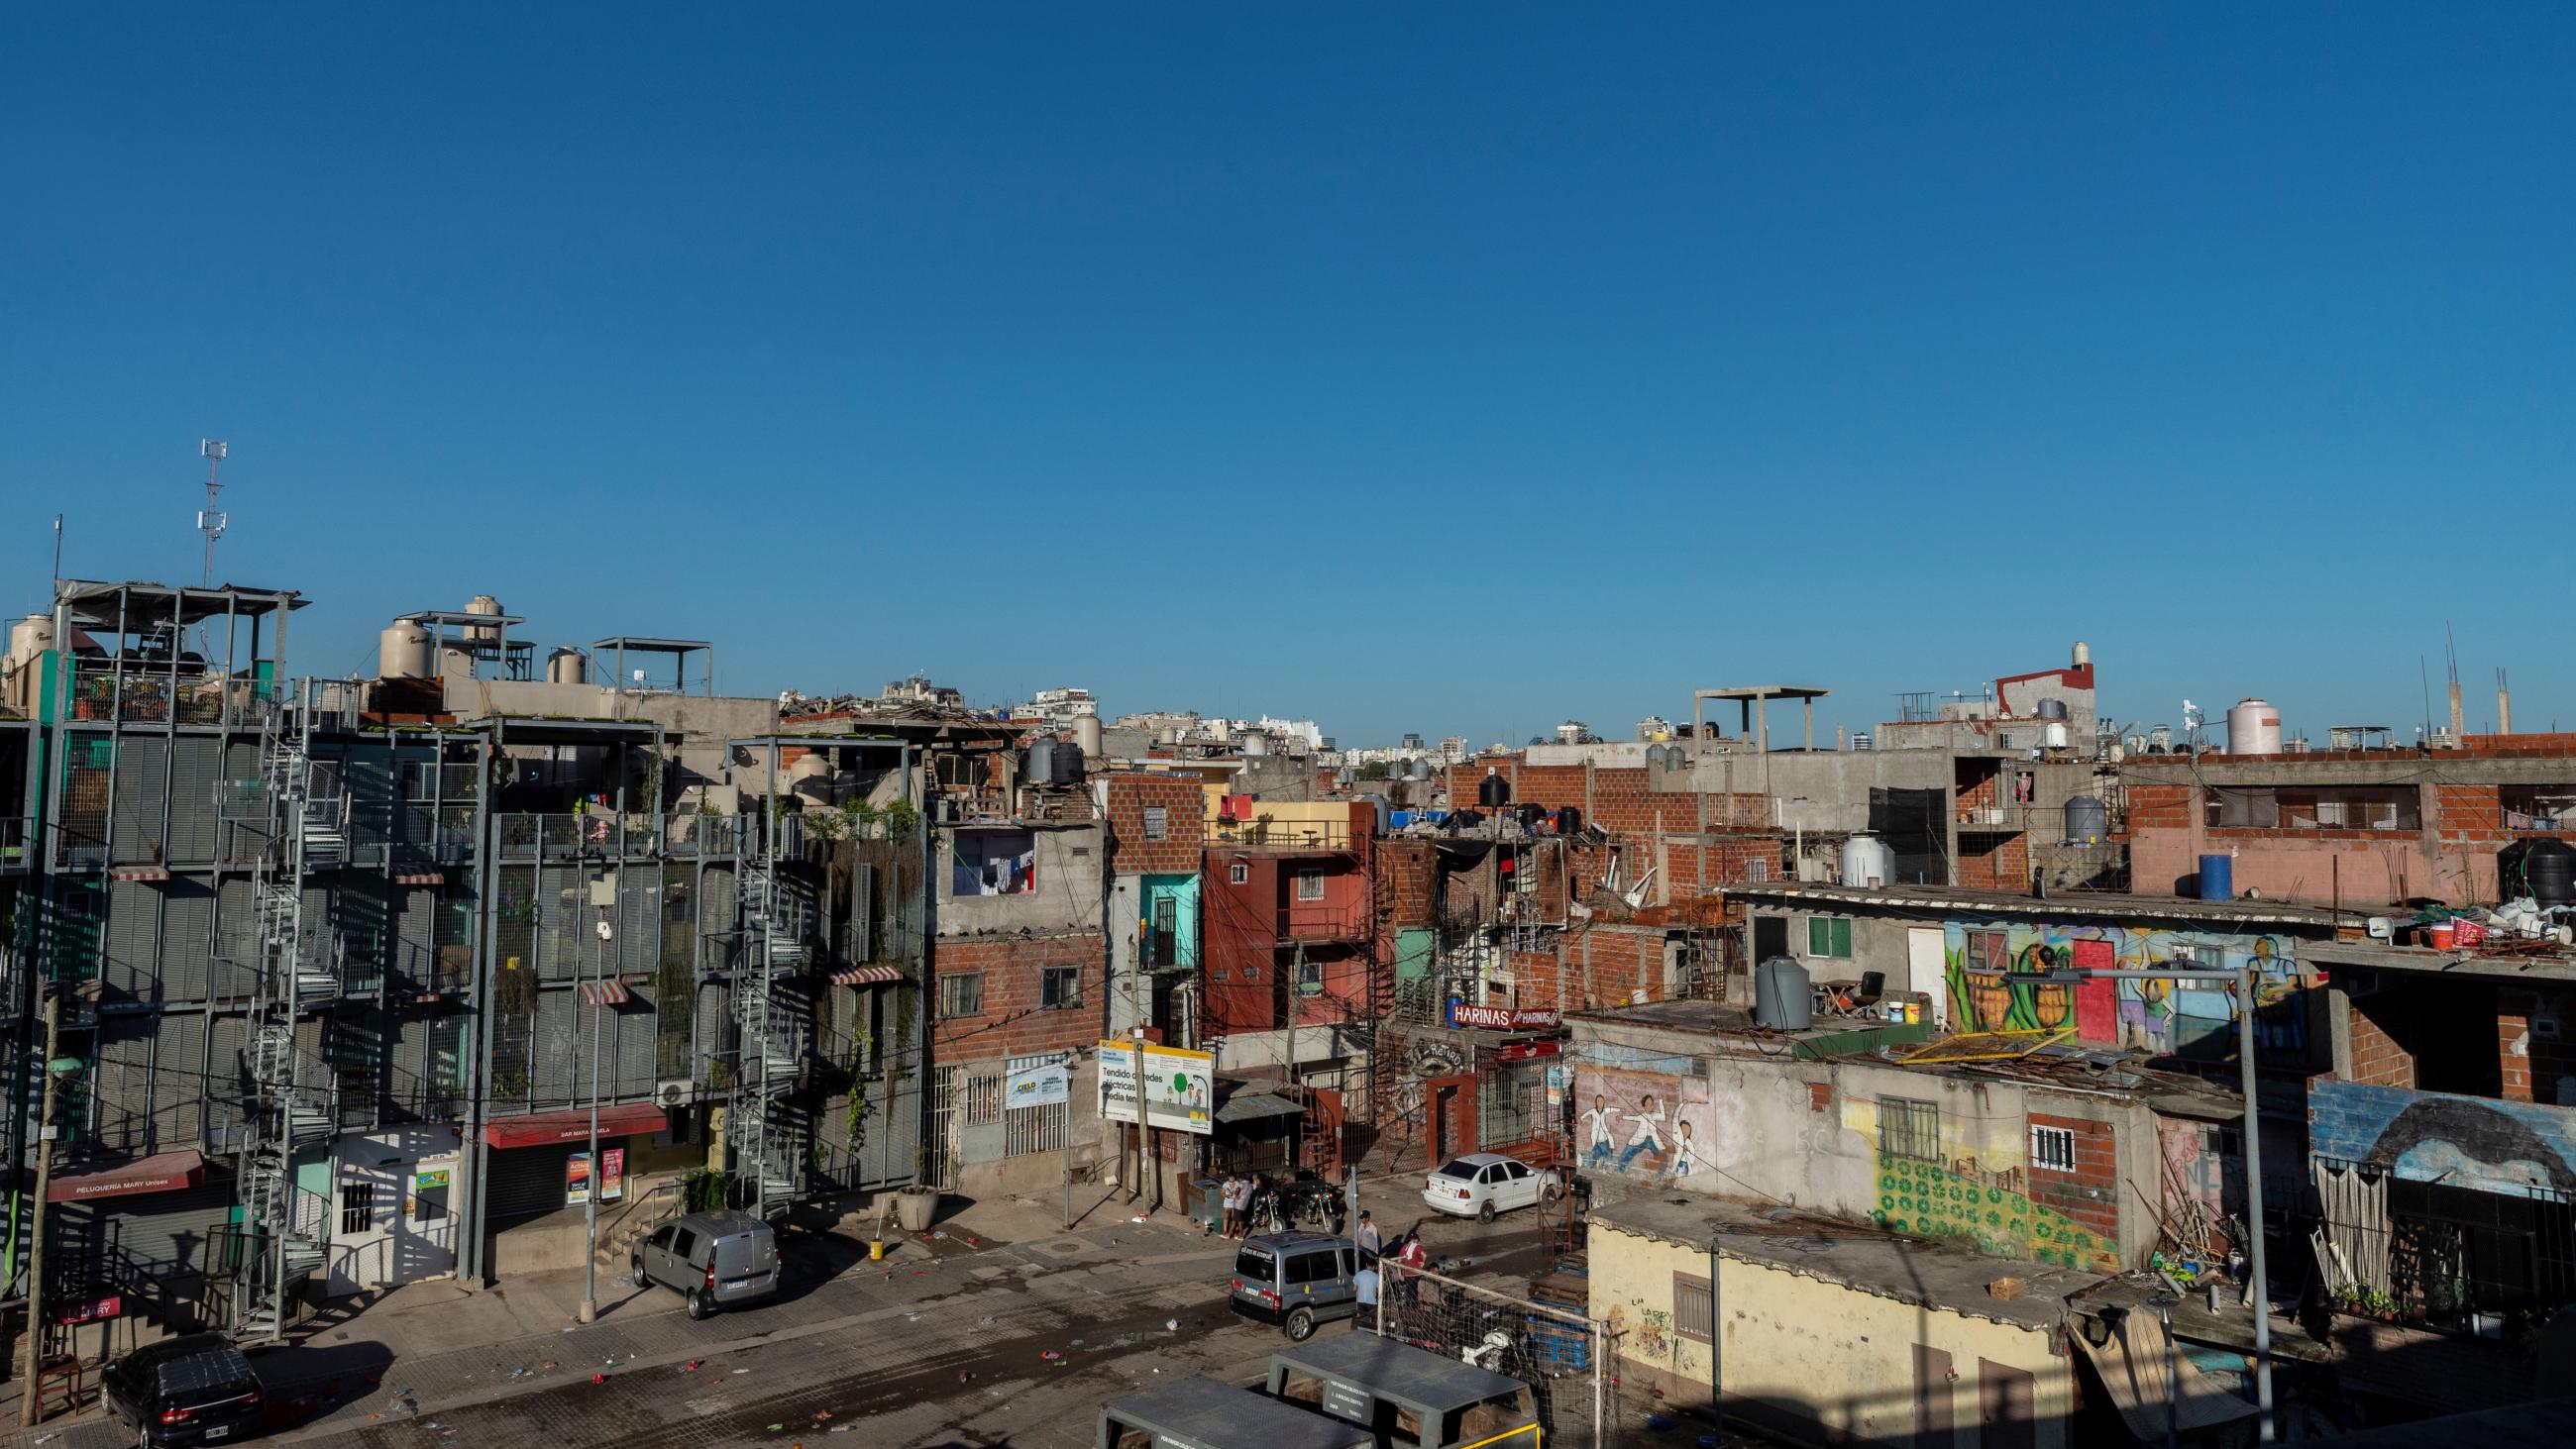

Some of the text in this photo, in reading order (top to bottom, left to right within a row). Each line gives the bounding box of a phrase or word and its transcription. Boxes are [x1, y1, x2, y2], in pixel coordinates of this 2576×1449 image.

[1454, 1005, 1509, 1026] HARINAS
[1522, 1011, 1550, 1024] HARINAS
[1102, 1067, 1130, 1079] Tendido
[1017, 1082, 1036, 1091] CIELO
[1102, 1080, 1136, 1091] eléctricas
[76, 1182, 122, 1193] PELUQUERÍA
[123, 1181, 144, 1190] MARY
[80, 1305, 111, 1318] MARY
